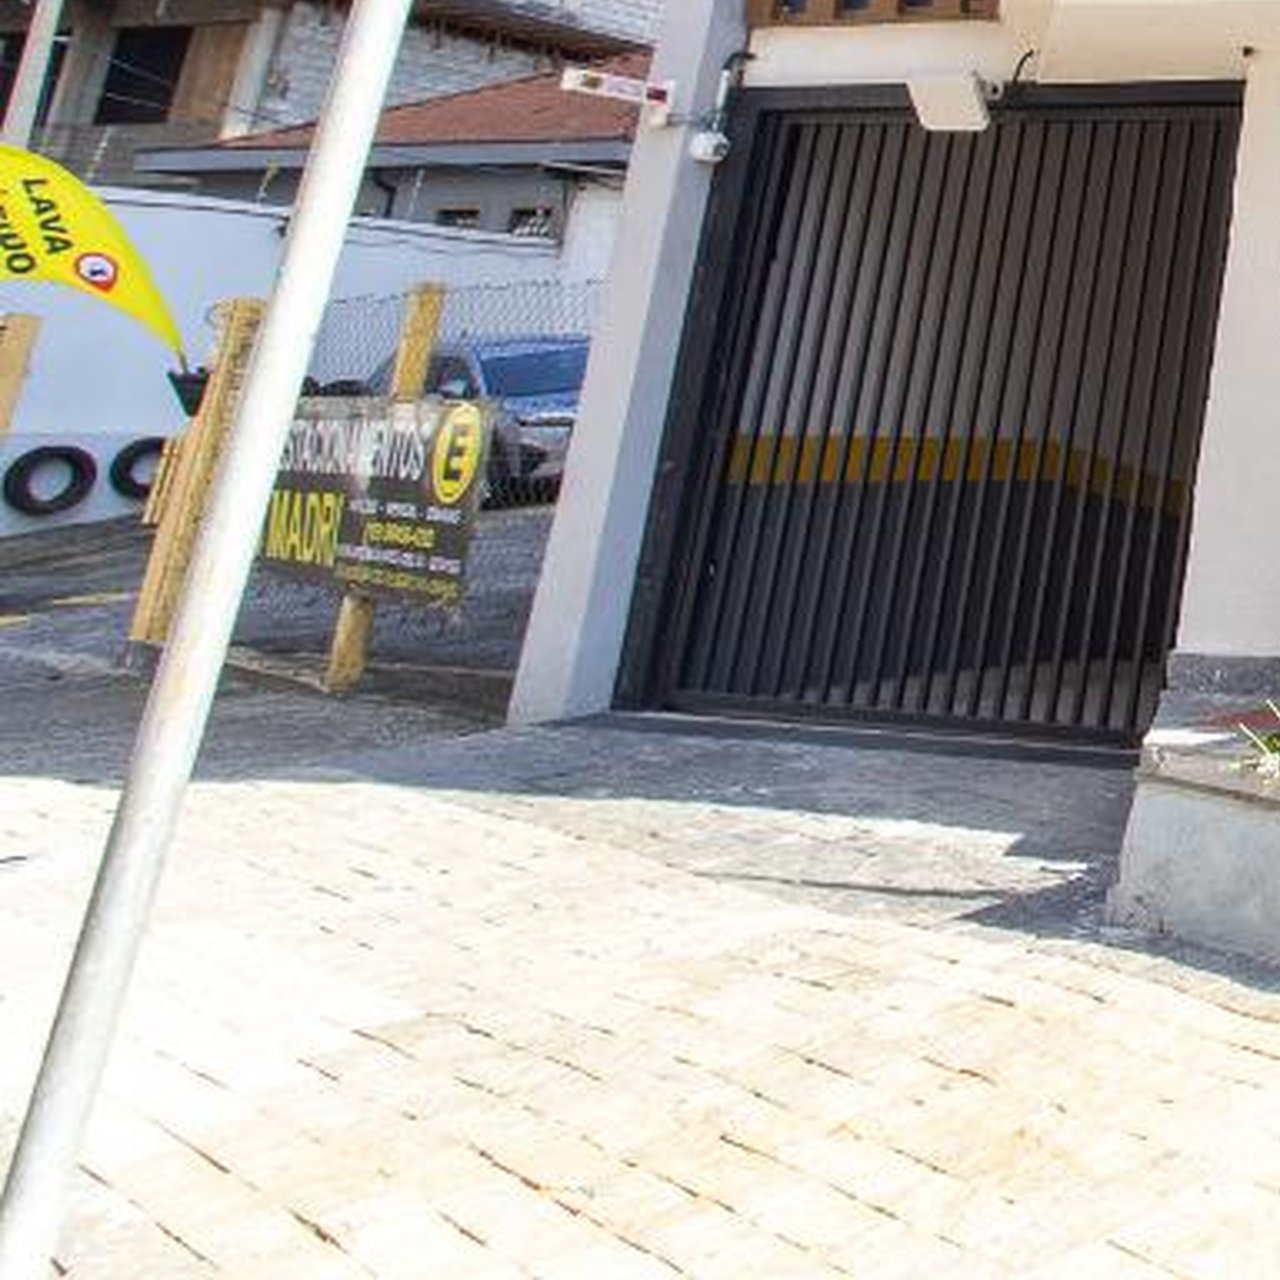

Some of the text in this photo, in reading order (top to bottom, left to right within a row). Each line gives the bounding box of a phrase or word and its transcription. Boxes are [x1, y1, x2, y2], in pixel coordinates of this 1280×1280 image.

[22, 178, 74, 254] LAVA
[280, 419, 425, 481] STACIONAMENTOS
[443, 426, 470, 481] E
